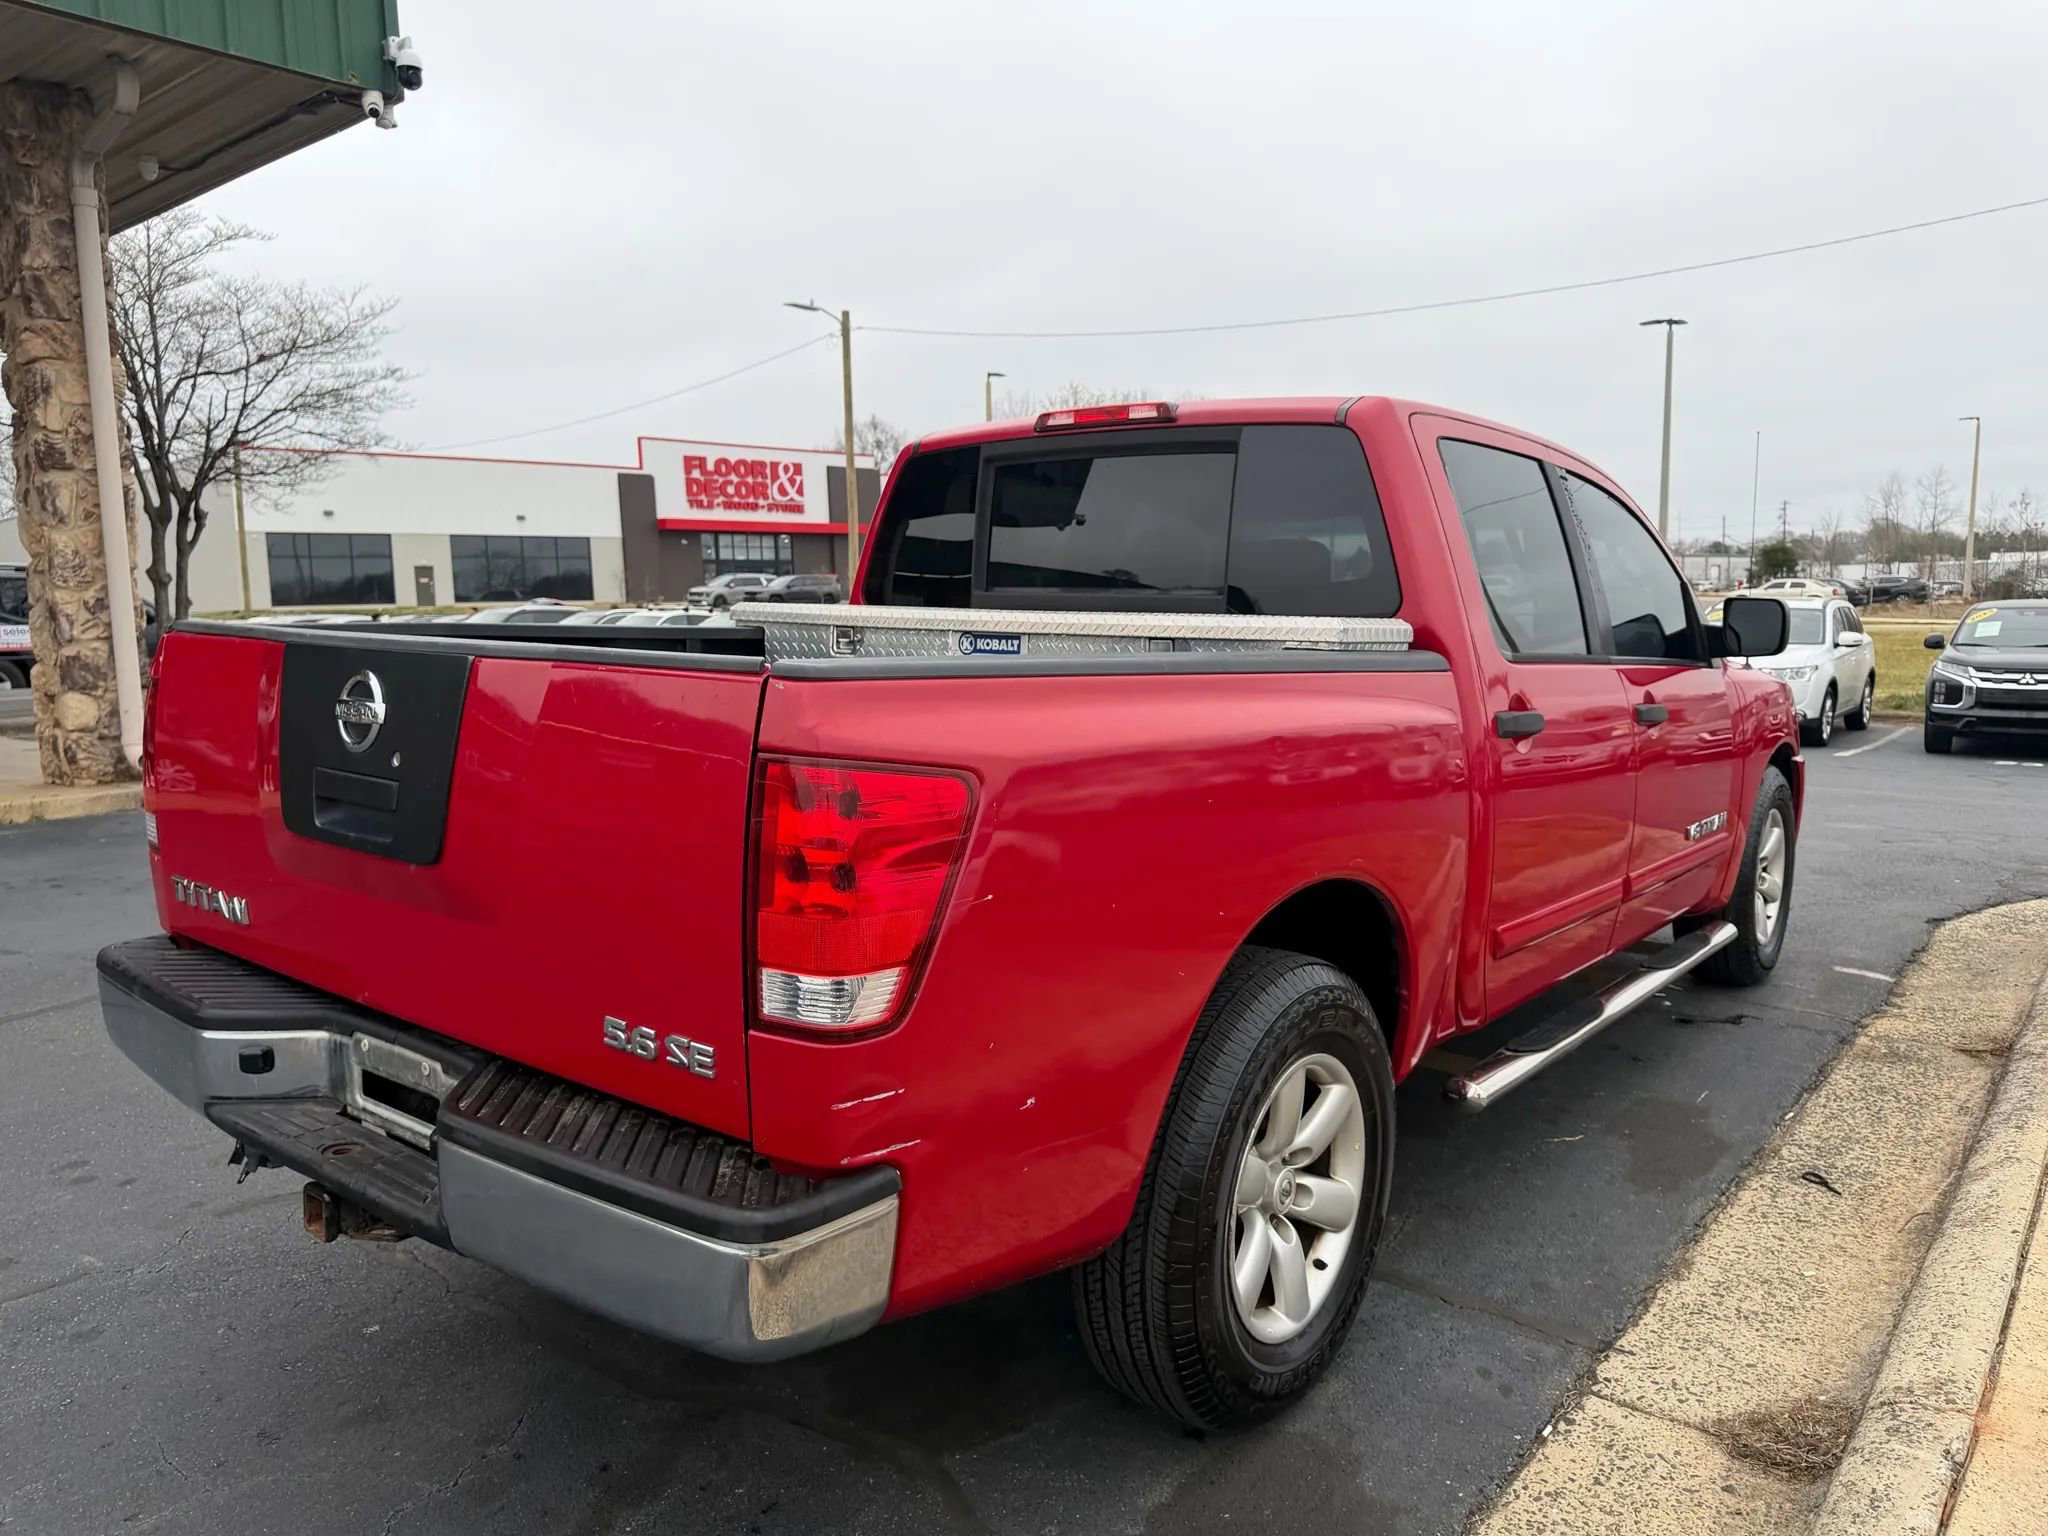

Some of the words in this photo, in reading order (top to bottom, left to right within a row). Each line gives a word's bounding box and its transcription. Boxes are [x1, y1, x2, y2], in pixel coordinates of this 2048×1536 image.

[683, 455, 768, 479] FLOOR
[771, 462, 804, 501] &
[685, 477, 770, 501] DECOR
[687, 499, 714, 510] TILE
[722, 501, 759, 512] WOOD
[766, 503, 804, 514] STONE
[976, 638, 1020, 651] KOBALT
[335, 702, 376, 720] NISSAN
[171, 874, 250, 926] TITAN
[603, 1015, 657, 1061] 5.6
[664, 1034, 716, 1079] SE
